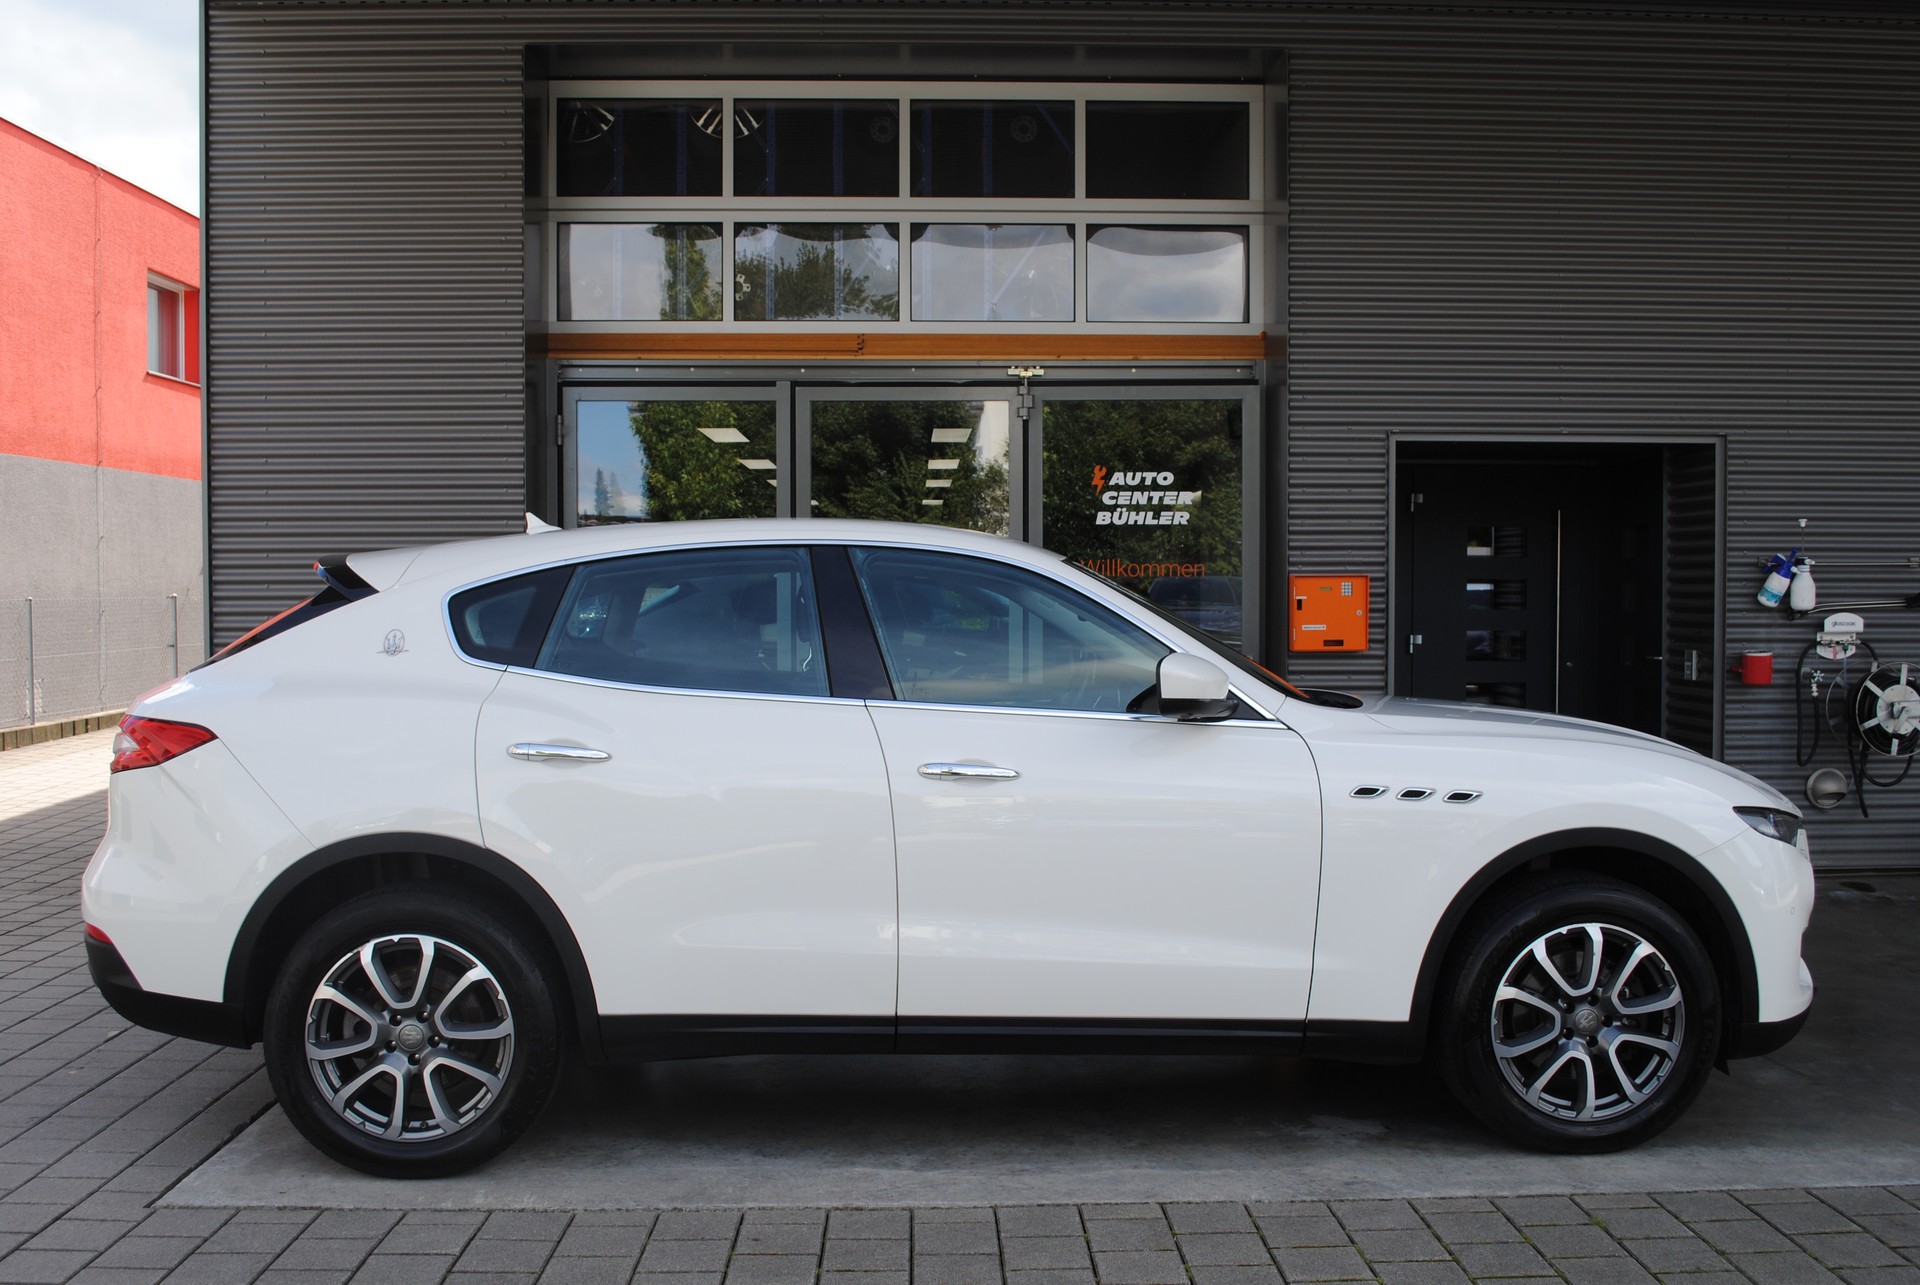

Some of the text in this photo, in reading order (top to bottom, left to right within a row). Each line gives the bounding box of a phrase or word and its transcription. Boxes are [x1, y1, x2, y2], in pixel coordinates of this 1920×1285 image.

[1108, 471, 1175, 486] AUTO
[1101, 491, 1194, 506] CENTER
[1095, 507, 1191, 525] BÜHLER
[1080, 558, 1206, 577] Willkommen
